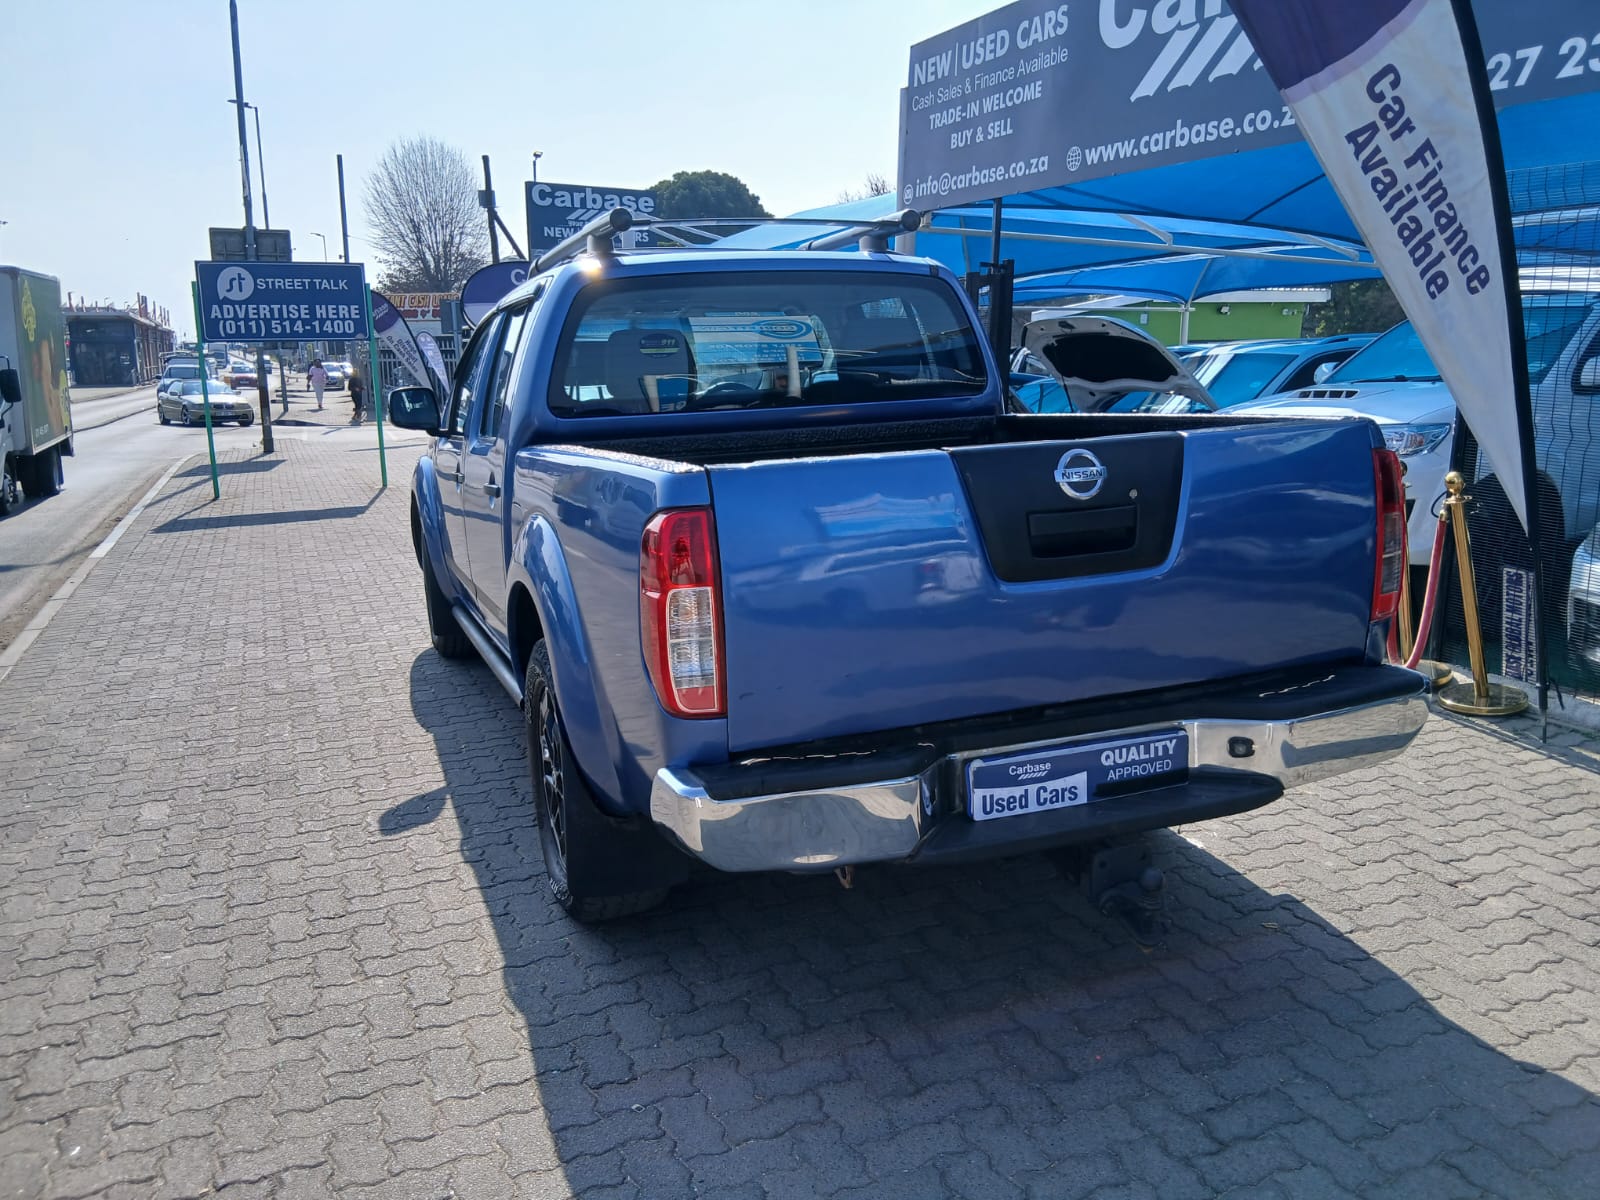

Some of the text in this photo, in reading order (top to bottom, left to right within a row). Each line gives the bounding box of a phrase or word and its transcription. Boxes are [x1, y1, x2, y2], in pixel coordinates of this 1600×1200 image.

[913, 4, 1069, 87] NEW USED CARS
[912, 45, 1069, 111] Cash Sales & Finance Available
[1486, 45, 1543, 91] 27
[929, 80, 1043, 130] TRADE-IN WELCOME
[950, 118, 1013, 149] BUY & SELL
[915, 155, 1049, 197] info@carbase.co.za
[1365, 63, 1491, 296] Car Finance
[531, 184, 655, 212] Carbase
[1344, 120, 1450, 300] Available
[543, 226, 573, 237] NEW
[257, 278, 348, 290] STREET TALK
[210, 304, 310, 319] ADVERTISE
[316, 305, 361, 319] HERE
[219, 320, 355, 337] (011) 514-1400
[1061, 470, 1103, 480] NISSAN
[1100, 739, 1177, 767] QUALITY
[1009, 762, 1052, 775] Carbase
[1107, 759, 1172, 781] APPROVED
[981, 784, 1079, 815] Used Cars
